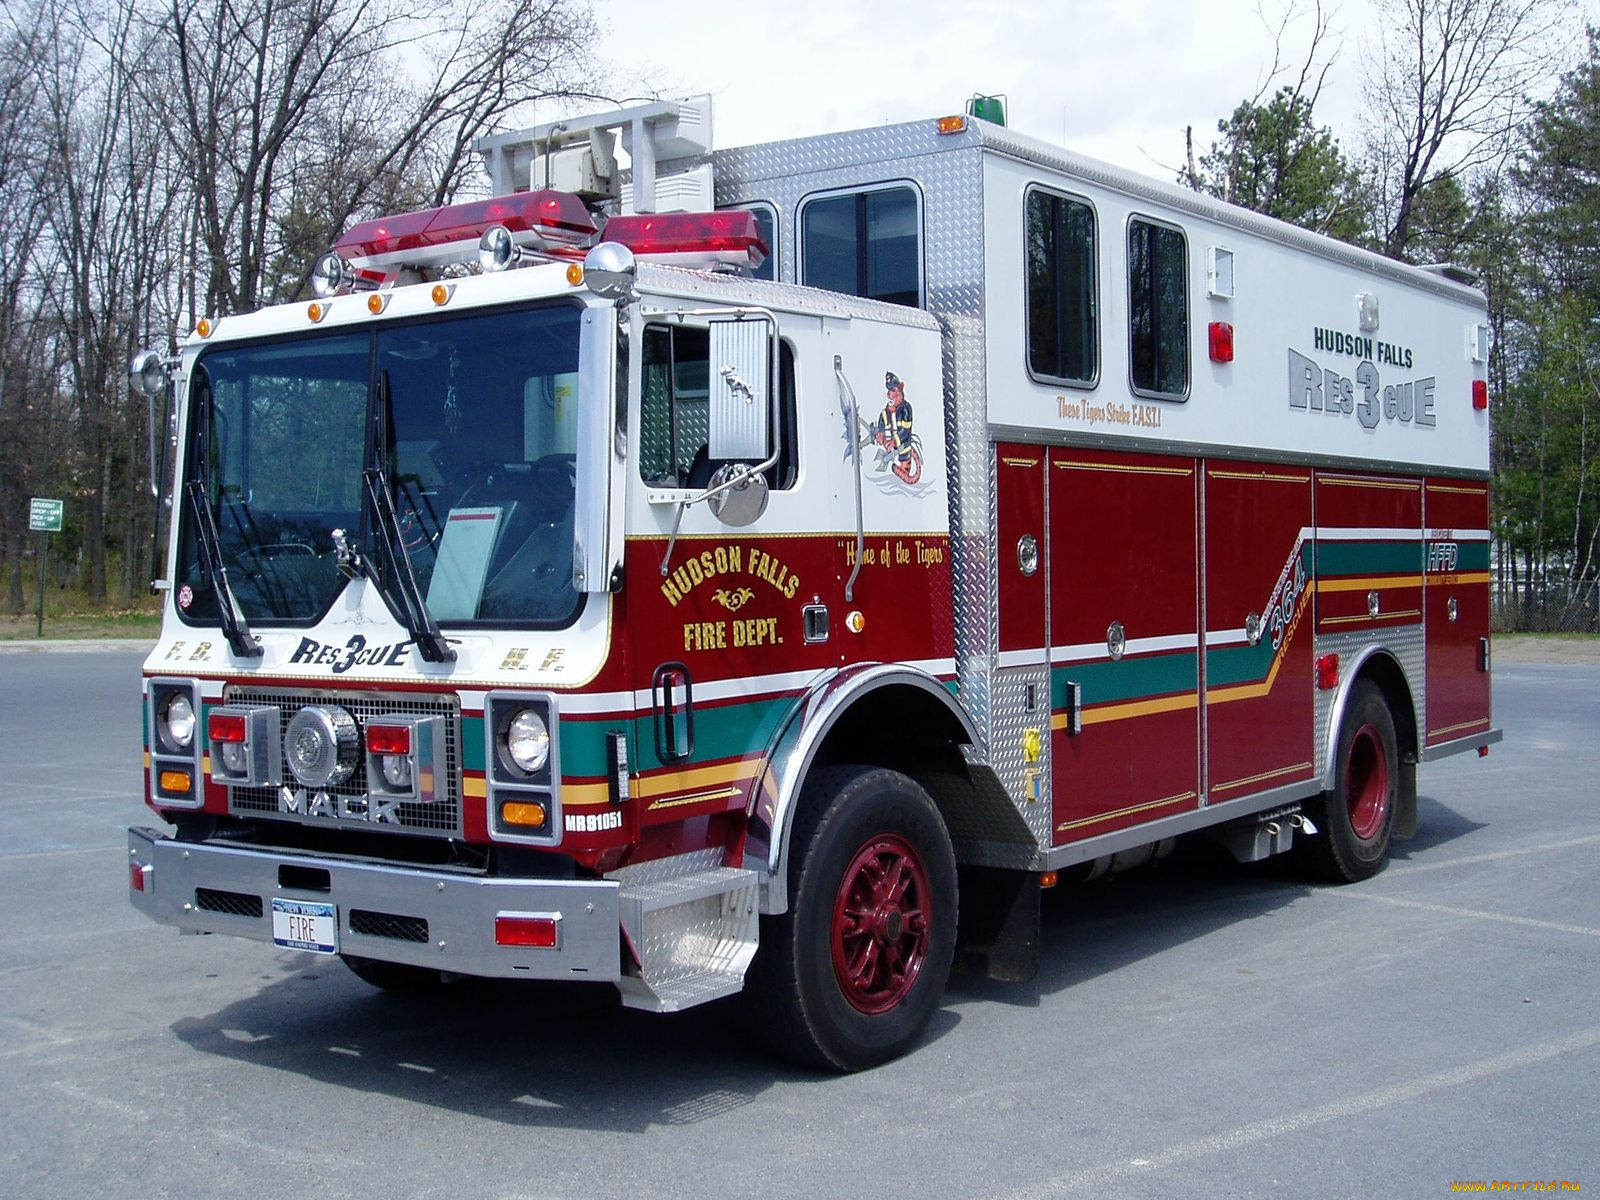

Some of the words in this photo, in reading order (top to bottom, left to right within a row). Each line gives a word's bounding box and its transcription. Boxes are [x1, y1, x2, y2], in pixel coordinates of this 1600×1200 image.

[1314, 326, 1373, 360] HUDSON
[1376, 341, 1413, 369] FALLS
[1057, 395, 1080, 420] These
[1081, 399, 1106, 426] Tigers
[1106, 402, 1131, 425] Strike
[881, 540, 891, 568] of
[896, 540, 911, 565] the
[1427, 542, 1458, 572] HFFD
[660, 545, 742, 608] HUDSON
[748, 547, 800, 600] FALLS
[1269, 555, 1306, 651] 364
[683, 620, 727, 651] FIRE
[732, 617, 784, 648] DEPT.
[1278, 590, 1309, 666] RESCUE
[278, 786, 402, 826] MACK
[289, 916, 316, 942] FIRE
